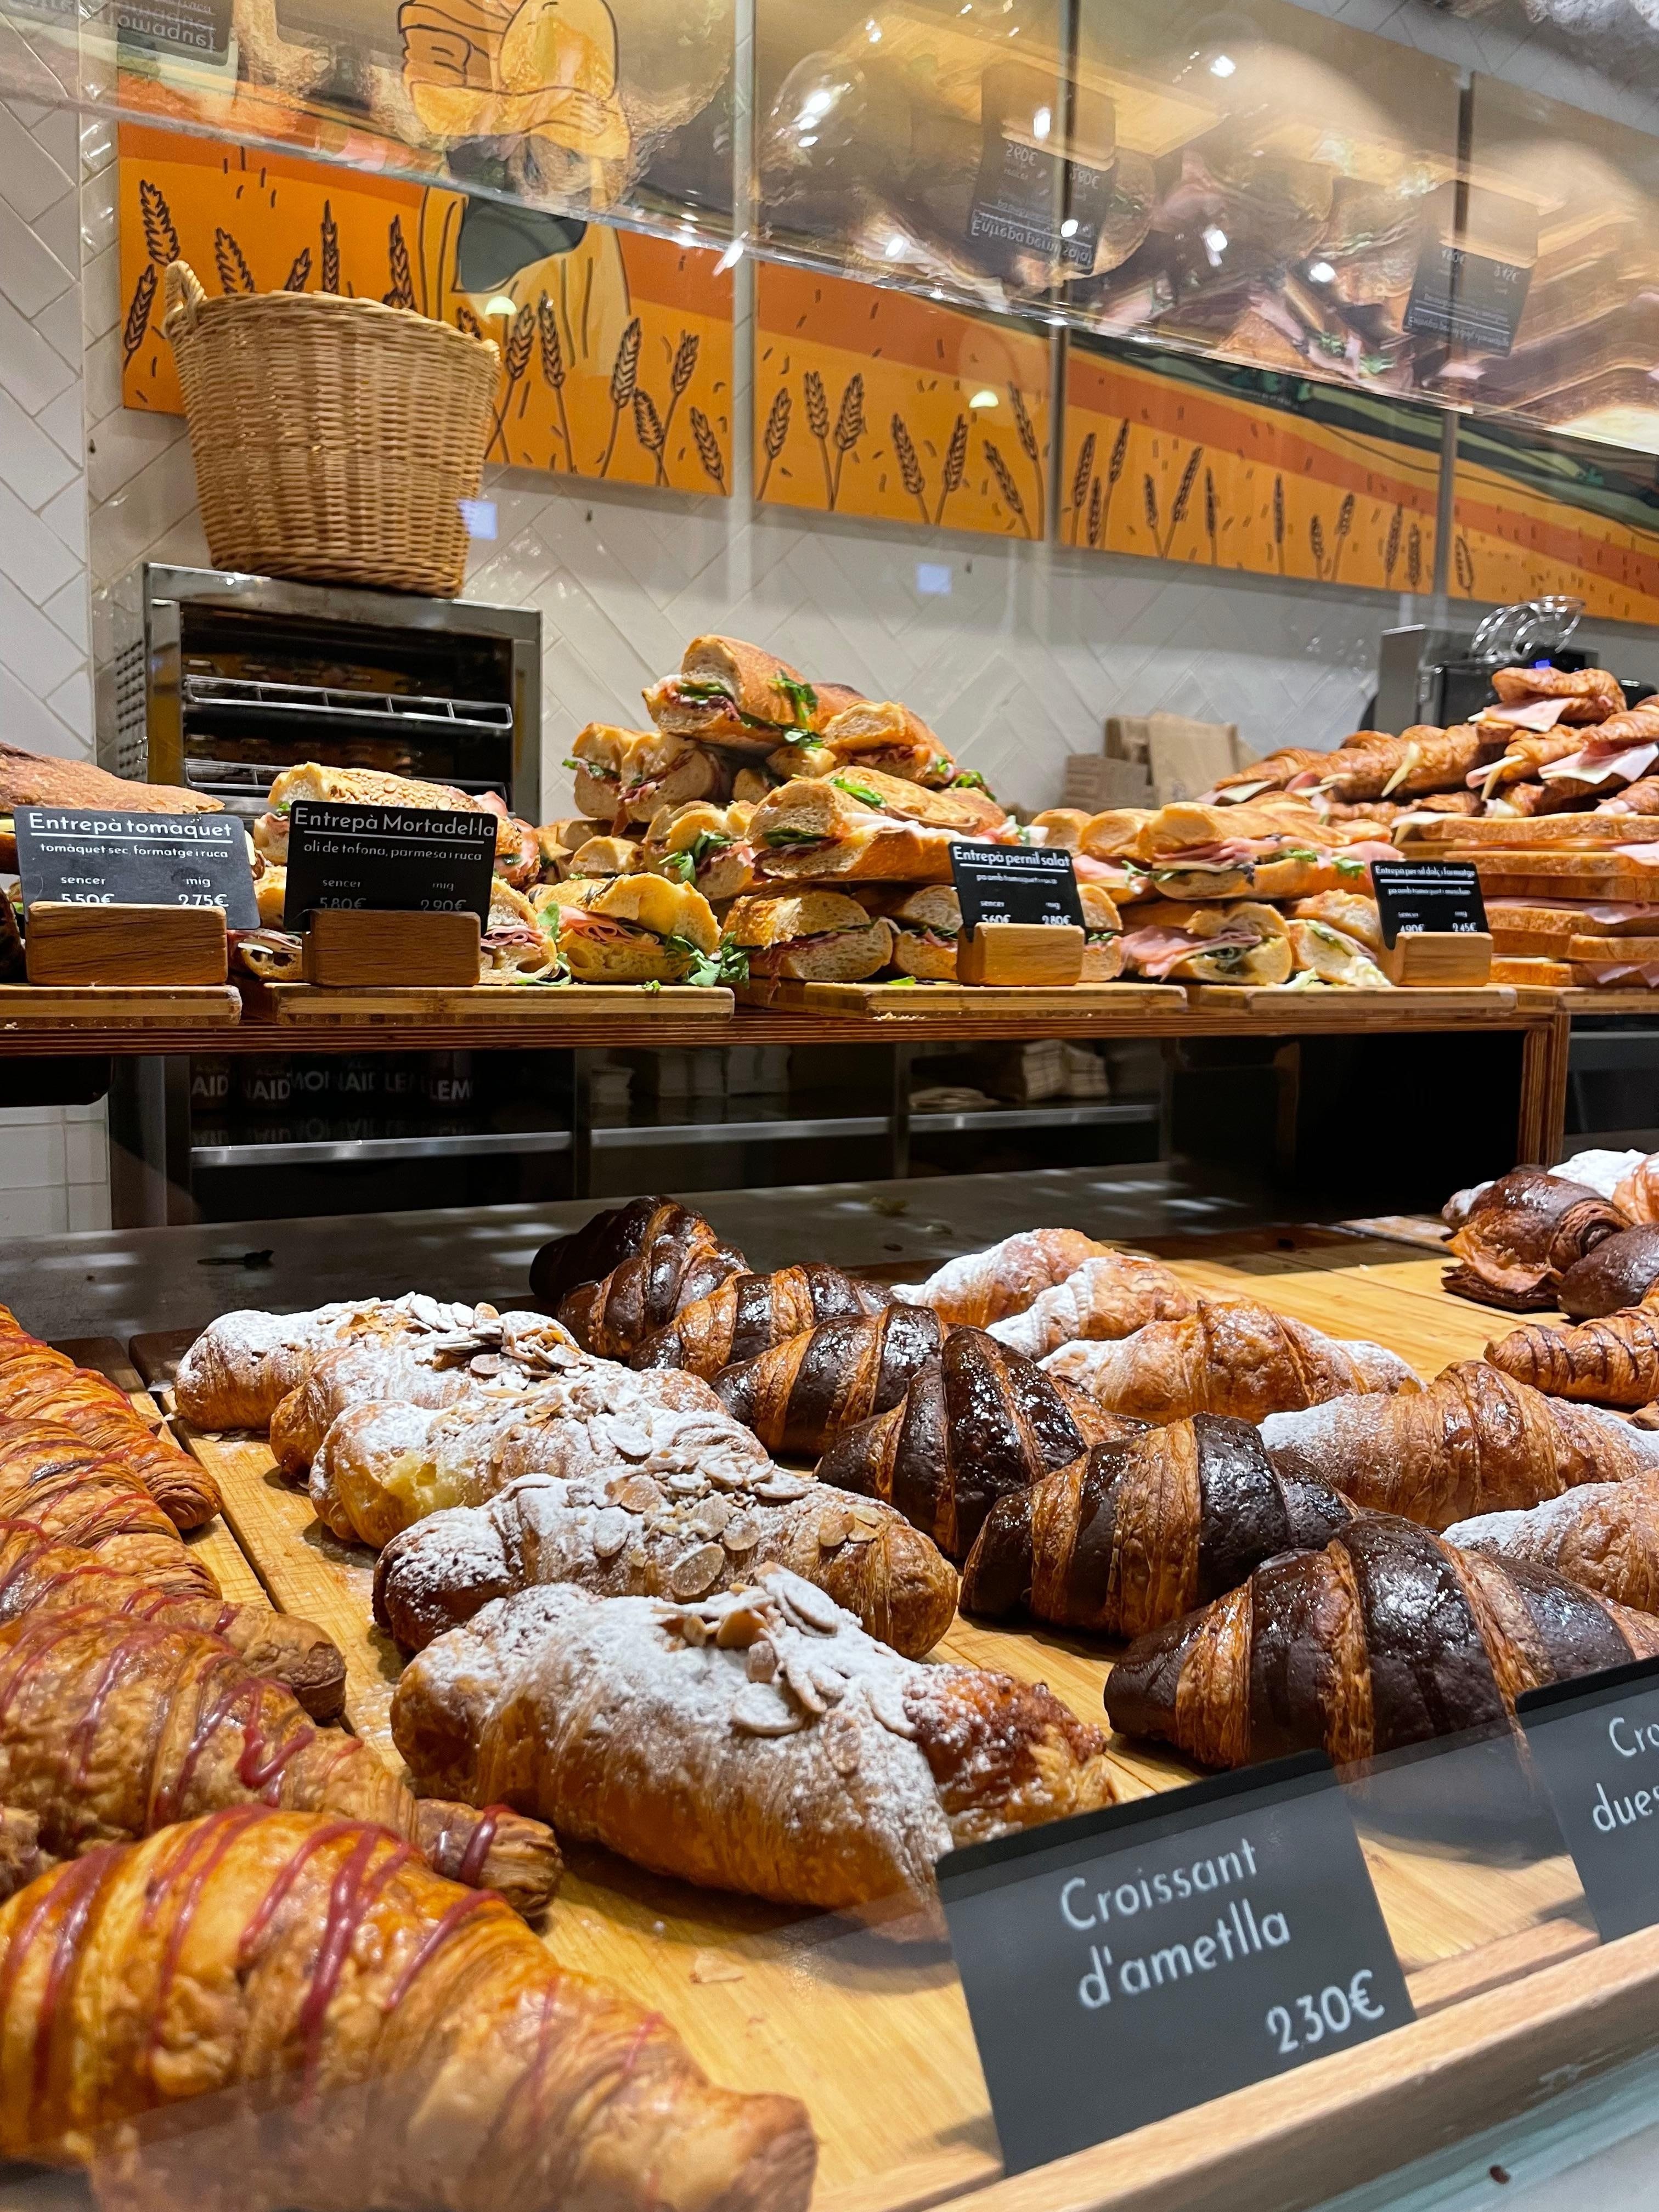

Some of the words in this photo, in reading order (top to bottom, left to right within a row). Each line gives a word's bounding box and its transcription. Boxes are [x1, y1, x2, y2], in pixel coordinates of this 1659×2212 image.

[29, 812, 122, 834] Entrepà
[126, 819, 232, 839] tomaquet
[295, 807, 378, 833] Entrepà
[40, 843, 106, 855] tomàquet
[133, 845, 193, 859] formatge
[303, 840, 320, 852] oli
[323, 840, 339, 854] de
[454, 852, 482, 861] ruca
[952, 846, 1005, 865] Entrepà
[1005, 851, 1040, 866] pernil
[1042, 853, 1070, 867] salat
[61, 876, 106, 885] sencer
[185, 877, 212, 888] mig
[1059, 1838, 1257, 1930] Croissant
[1078, 1898, 1291, 2009] d'ametlla
